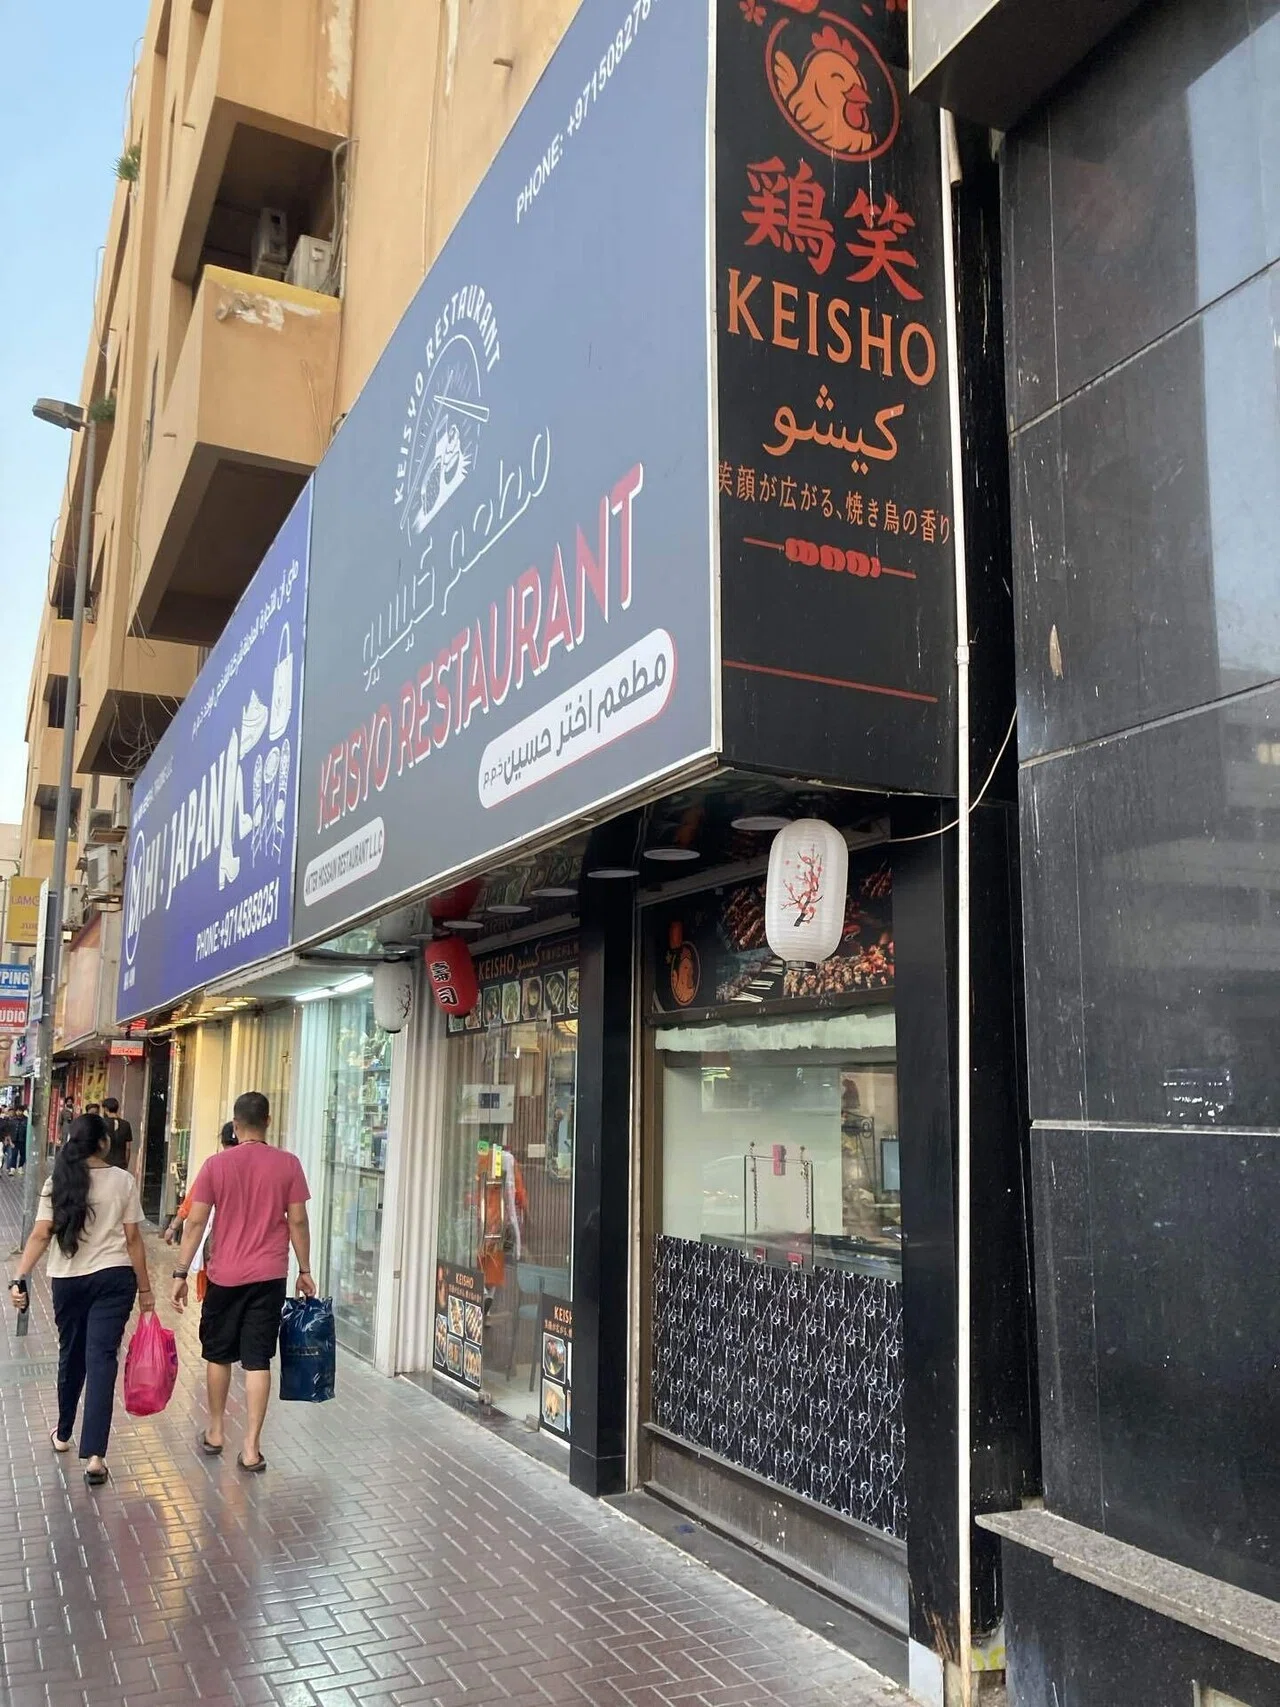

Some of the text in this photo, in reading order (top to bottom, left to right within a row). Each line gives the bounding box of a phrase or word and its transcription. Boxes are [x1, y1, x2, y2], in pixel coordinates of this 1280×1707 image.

[516, 0, 657, 224] PHONE: +971508278
[426, 284, 500, 372] RESTAURANT
[727, 268, 936, 386] KEISHO
[763, 384, 905, 475] كيشو
[718, 461, 951, 544] 笑顔が広がる、焼き鳥の香り
[317, 703, 393, 835] KEISYO
[396, 463, 644, 777] RESTAURANT
[556, 688, 592, 757] اختر
[597, 653, 667, 734] مطعم
[503, 727, 552, 785] حسين
[165, 750, 226, 911] JAPAN
[0, 971, 29, 985] PING
[478, 953, 514, 981] KEISHO
[455, 1272, 474, 1289] KEISHO
